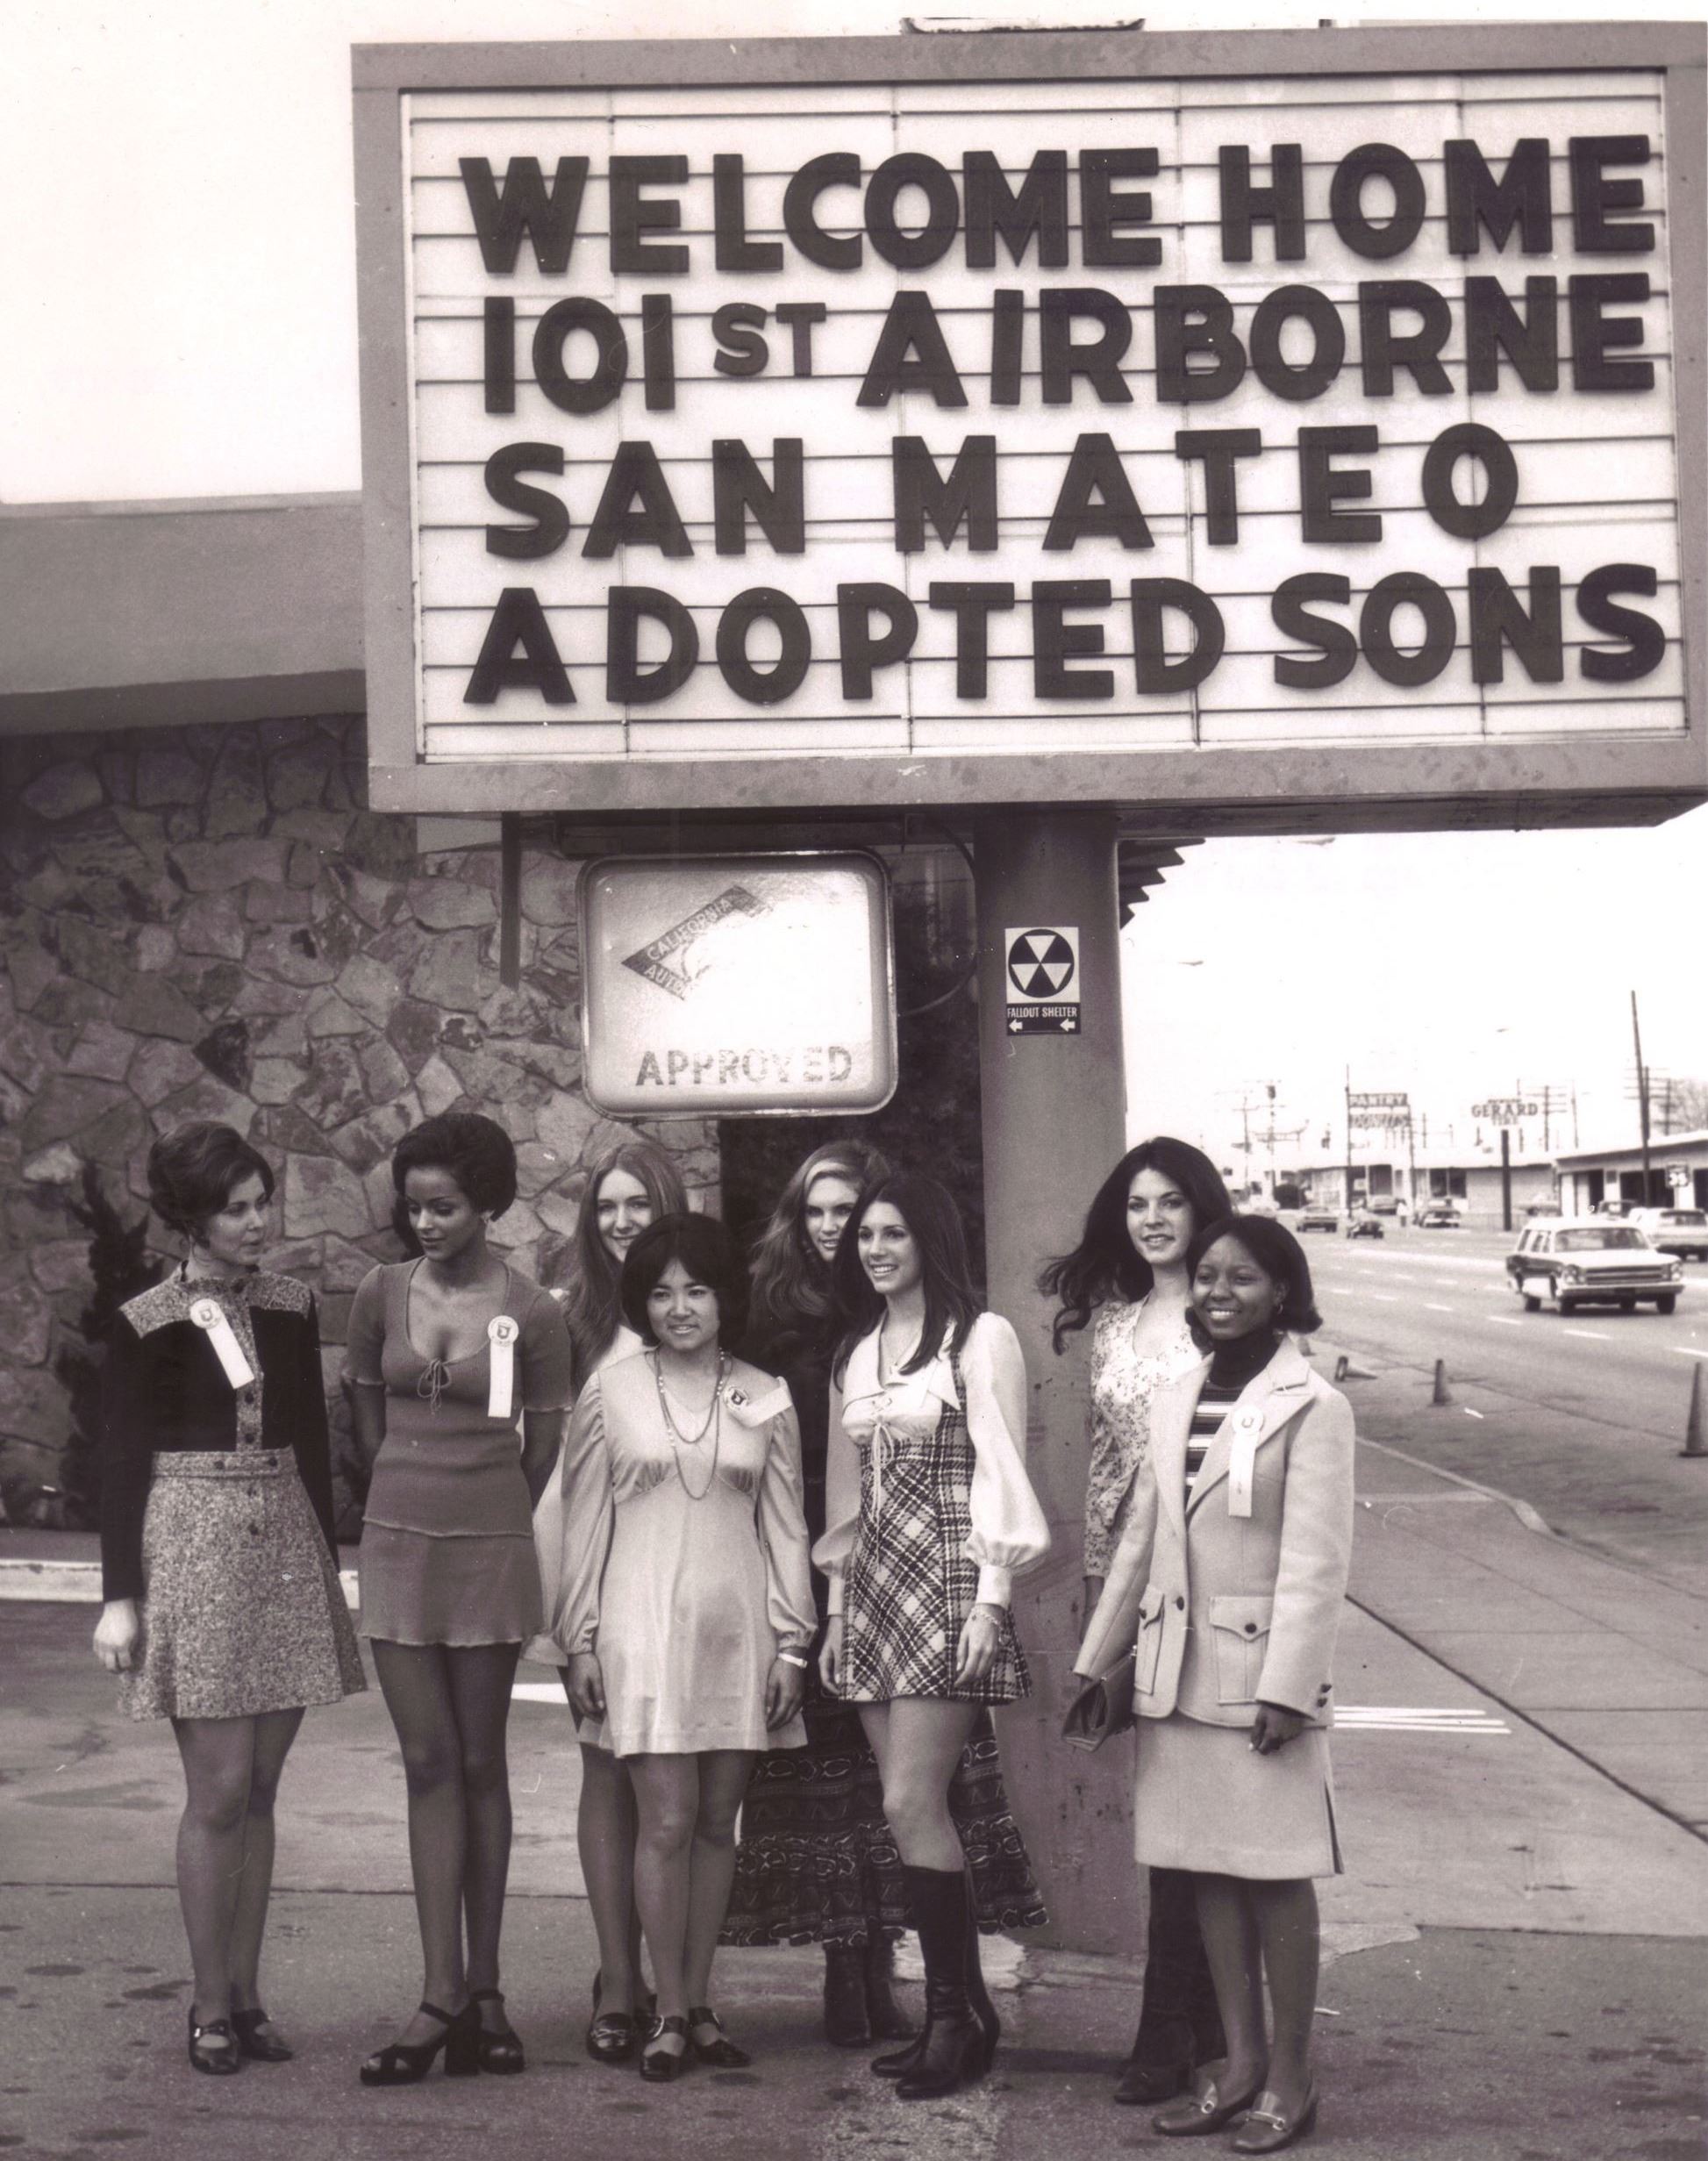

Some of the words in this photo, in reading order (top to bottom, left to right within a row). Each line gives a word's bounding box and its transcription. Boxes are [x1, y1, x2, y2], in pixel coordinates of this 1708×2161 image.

[461, 148, 1162, 274] WELCOME
[1219, 135, 1655, 262] HOME
[857, 273, 1654, 407] AIRBORNE
[484, 438, 805, 561] SAN
[892, 423, 1519, 552] MATEO
[464, 578, 1225, 705] ADOPTED
[1271, 564, 1666, 690] SONS
[646, 897, 733, 962] CALIFORNIA
[1007, 1006, 1040, 1018] FALLOUT
[1041, 1006, 1077, 1018] SHELTER
[635, 1045, 853, 1087] APPROVED
[1471, 1103, 1539, 1118] GERARD
